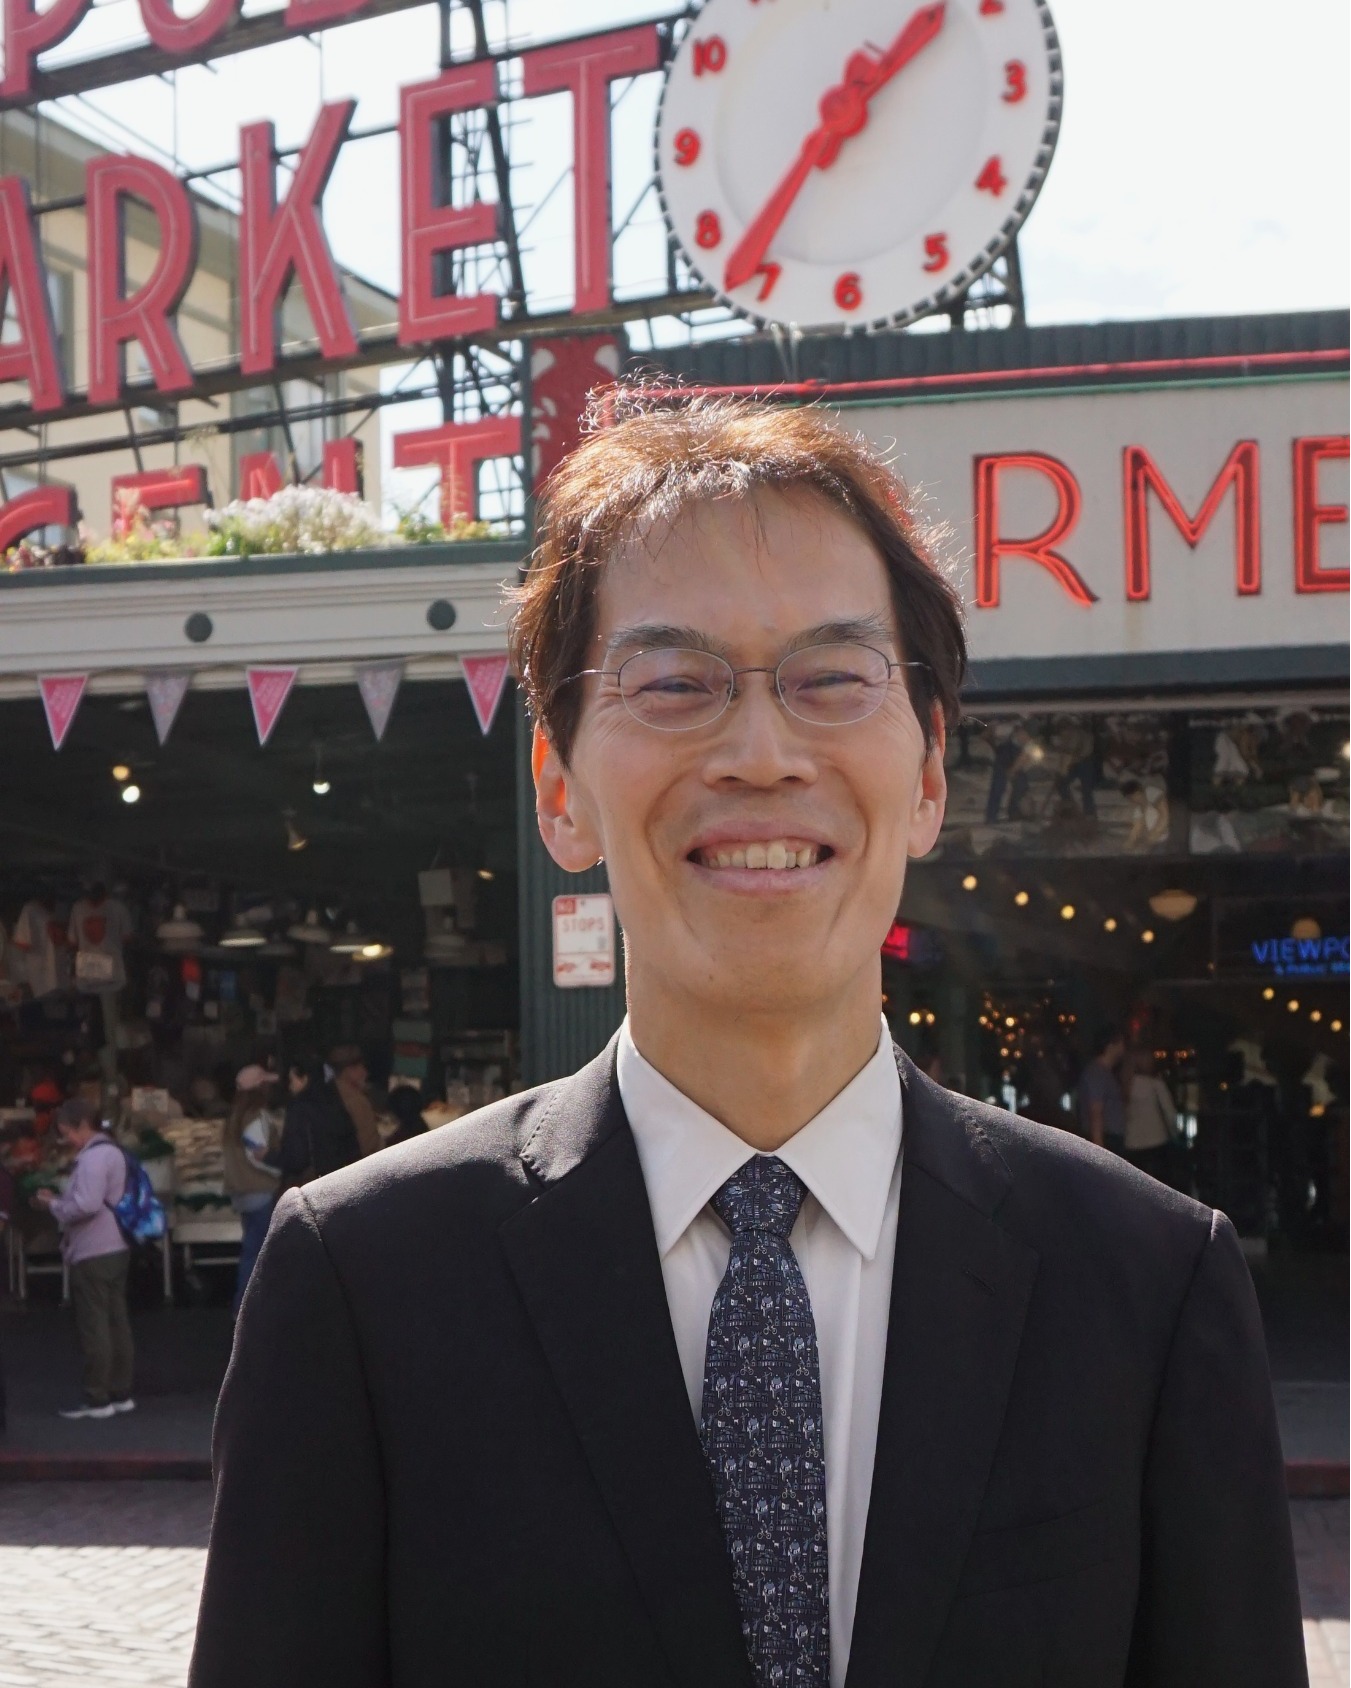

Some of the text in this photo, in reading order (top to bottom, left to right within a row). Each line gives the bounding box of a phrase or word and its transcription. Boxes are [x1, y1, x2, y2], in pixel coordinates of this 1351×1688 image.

[692, 34, 727, 77] 10
[1001, 59, 1028, 103] 3
[673, 127, 701, 167] 9
[975, 155, 1008, 198] 4
[694, 208, 722, 249] 8
[921, 232, 950, 273] 5
[754, 262, 783, 302] 7
[833, 271, 863, 311] 6
